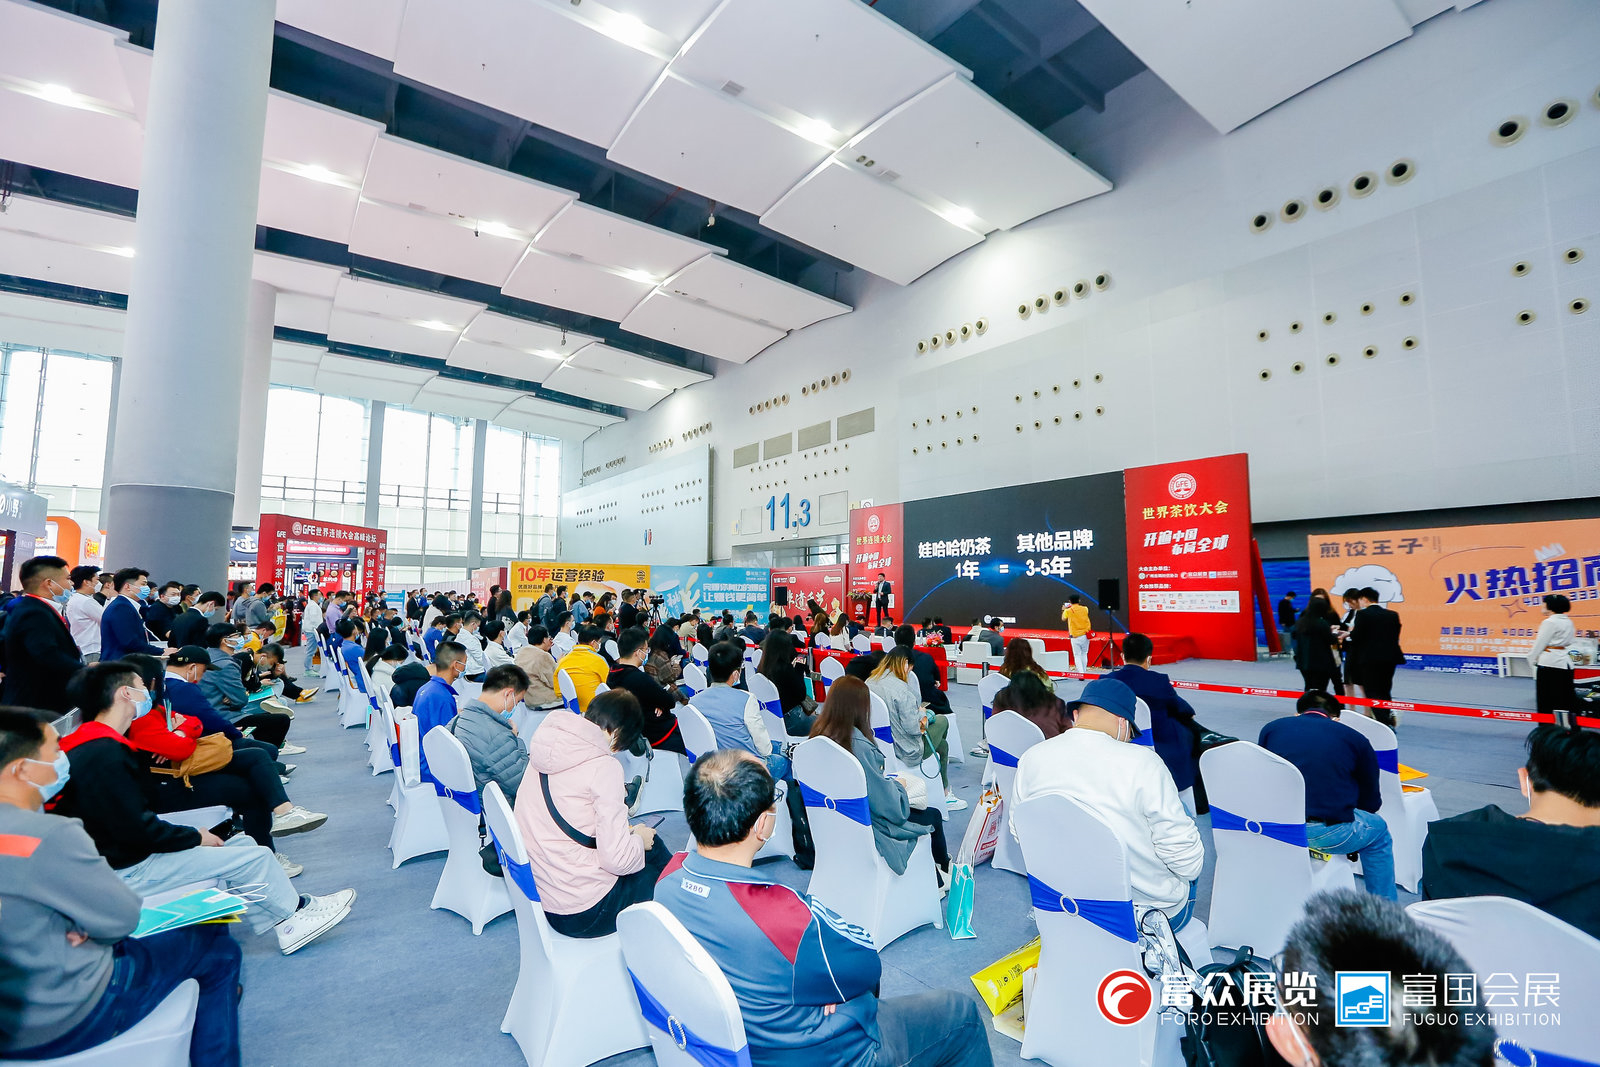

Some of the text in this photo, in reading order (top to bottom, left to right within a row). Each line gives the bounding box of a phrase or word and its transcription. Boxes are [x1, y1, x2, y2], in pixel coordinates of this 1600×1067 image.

[765, 492, 811, 531] 11.3
[1142, 500, 1229, 520] 世界茶饮大会
[918, 529, 1094, 558] 娃哈哈奶茶 其他品牌
[1143, 528, 1198, 547] 开遍中国
[1171, 534, 1229, 555] 布局全球
[1320, 538, 1423, 558] 煎饺王子
[275, 530, 287, 597] GFE世界茶饮
[365, 549, 376, 596] GFE创业开
[517, 567, 606, 582] 10年运营经验
[955, 560, 980, 580] 1年
[1025, 555, 1072, 578] 3-5年
